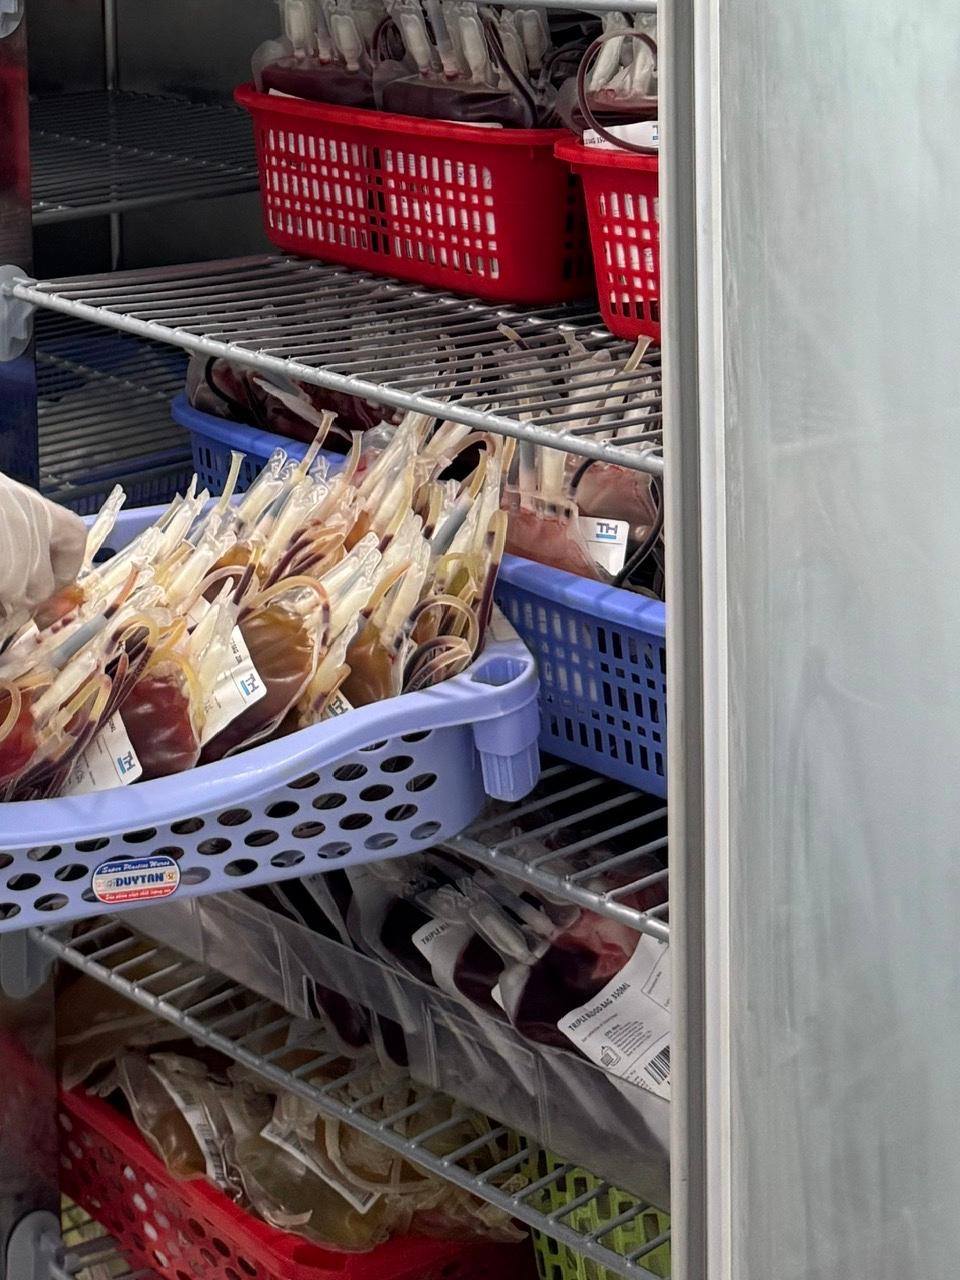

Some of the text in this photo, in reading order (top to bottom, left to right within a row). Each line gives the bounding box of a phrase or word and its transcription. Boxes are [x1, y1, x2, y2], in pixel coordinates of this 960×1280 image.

[596, 521, 619, 535] TH
[245, 673, 259, 693] TH
[122, 751, 136, 771] TH
[568, 1013, 588, 1032] TRIPLE
[585, 1004, 603, 1019] BLOOD
[600, 998, 613, 1009] BAG
[611, 982, 631, 1000] 350ML
